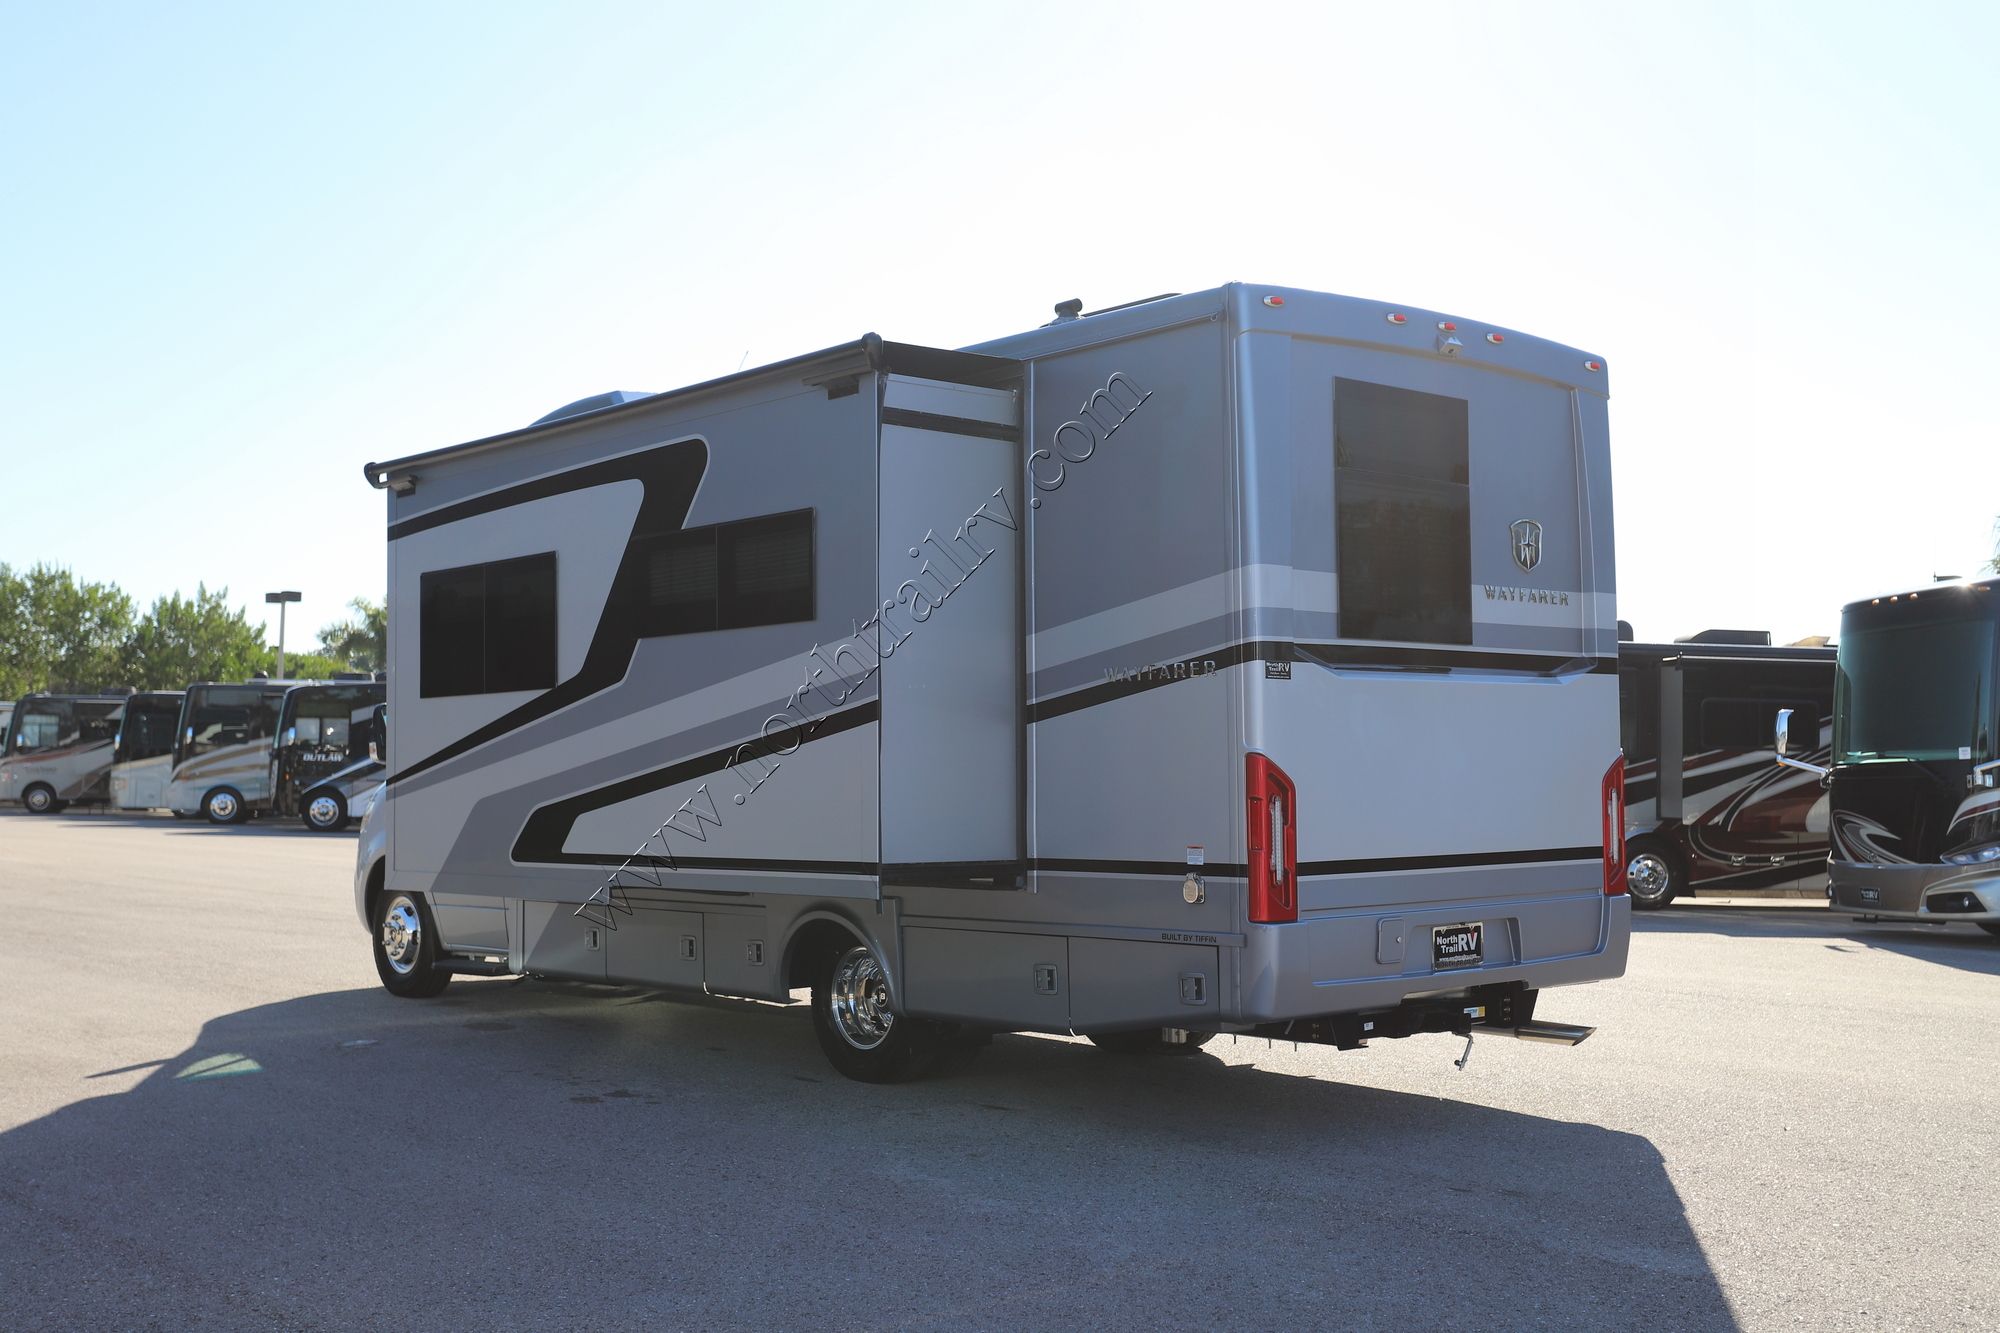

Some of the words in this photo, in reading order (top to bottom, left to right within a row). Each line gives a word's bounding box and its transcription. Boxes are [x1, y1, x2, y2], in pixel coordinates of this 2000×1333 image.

[1484, 584, 1569, 606] WAYFARER
[1104, 660, 1217, 682] WAYFARER
[303, 752, 344, 762] OUTLAW
[1161, 933, 1181, 941] BUILT
[1183, 934, 1193, 942] BY
[1195, 935, 1217, 943] TIFFIN
[1436, 935, 1458, 946] North
[1458, 932, 1478, 952] RV
[1440, 944, 1458, 954] Trail
